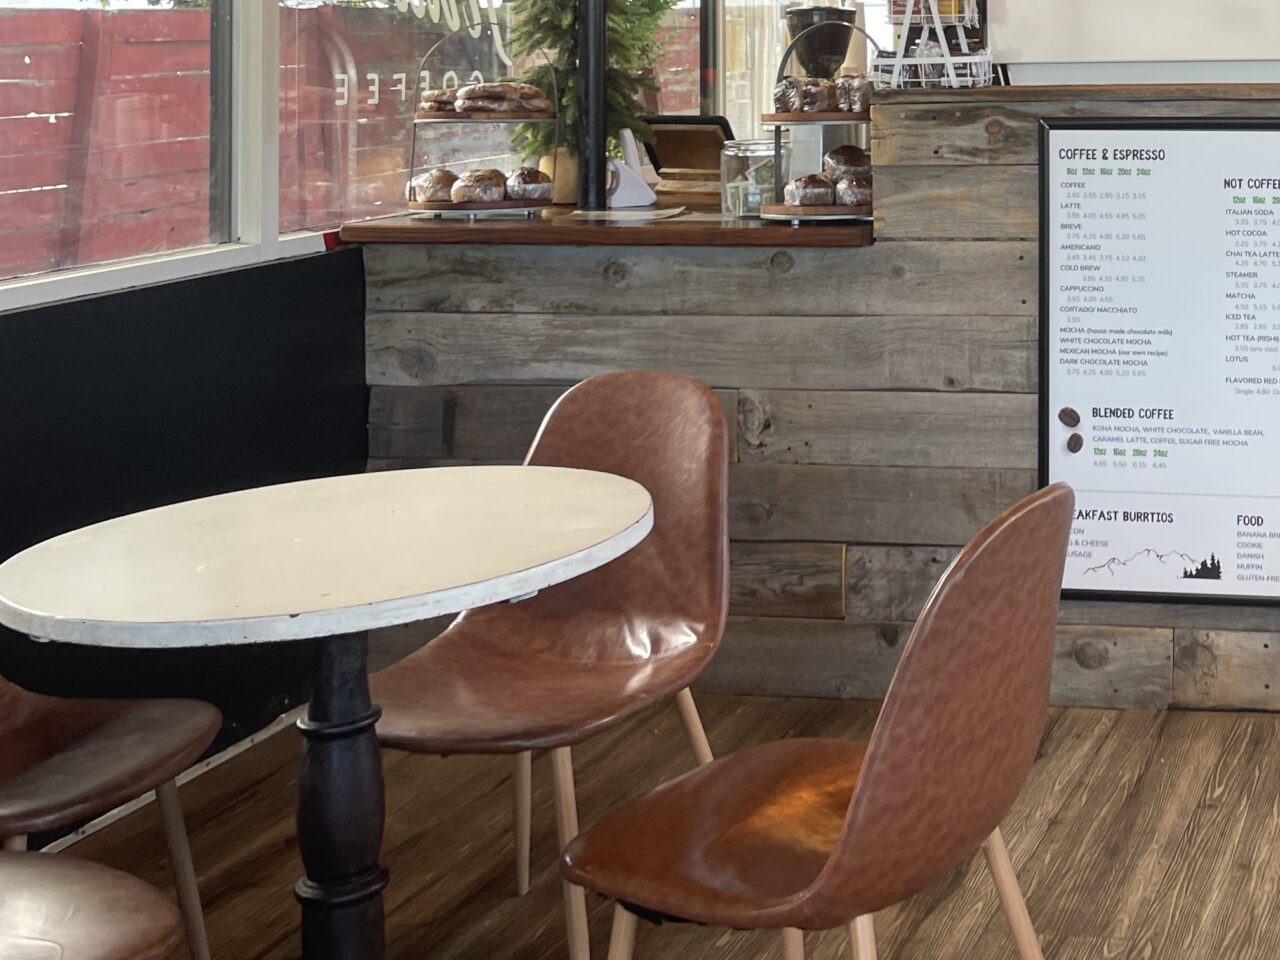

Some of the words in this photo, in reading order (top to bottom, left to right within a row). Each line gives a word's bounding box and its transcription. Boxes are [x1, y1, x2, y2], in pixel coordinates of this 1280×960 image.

[1058, 148, 1097, 160] COFFEE
[1101, 148, 1108, 160] &
[1113, 148, 1165, 160] ESPRESSO
[1224, 178, 1243, 189] NOT
[1244, 250, 1257, 258] TEA
[1258, 250, 1280, 258] LATTE
[1080, 358, 1120, 366] CHOCOLATE
[1225, 376, 1262, 384] FLAVORED
[1092, 407, 1134, 418] BLENDED
[1138, 408, 1173, 420] COFFEE
[1092, 424, 1112, 432] KONA
[1212, 428, 1242, 436] VANILLA
[1092, 435, 1124, 443] CARAMEL
[1204, 438, 1220, 446] FREE
[1122, 511, 1173, 523] BURRTIOS
[1237, 514, 1263, 526] FOOD
[1236, 530, 1267, 538] BANANA
[1236, 541, 1262, 549] COOKIE
